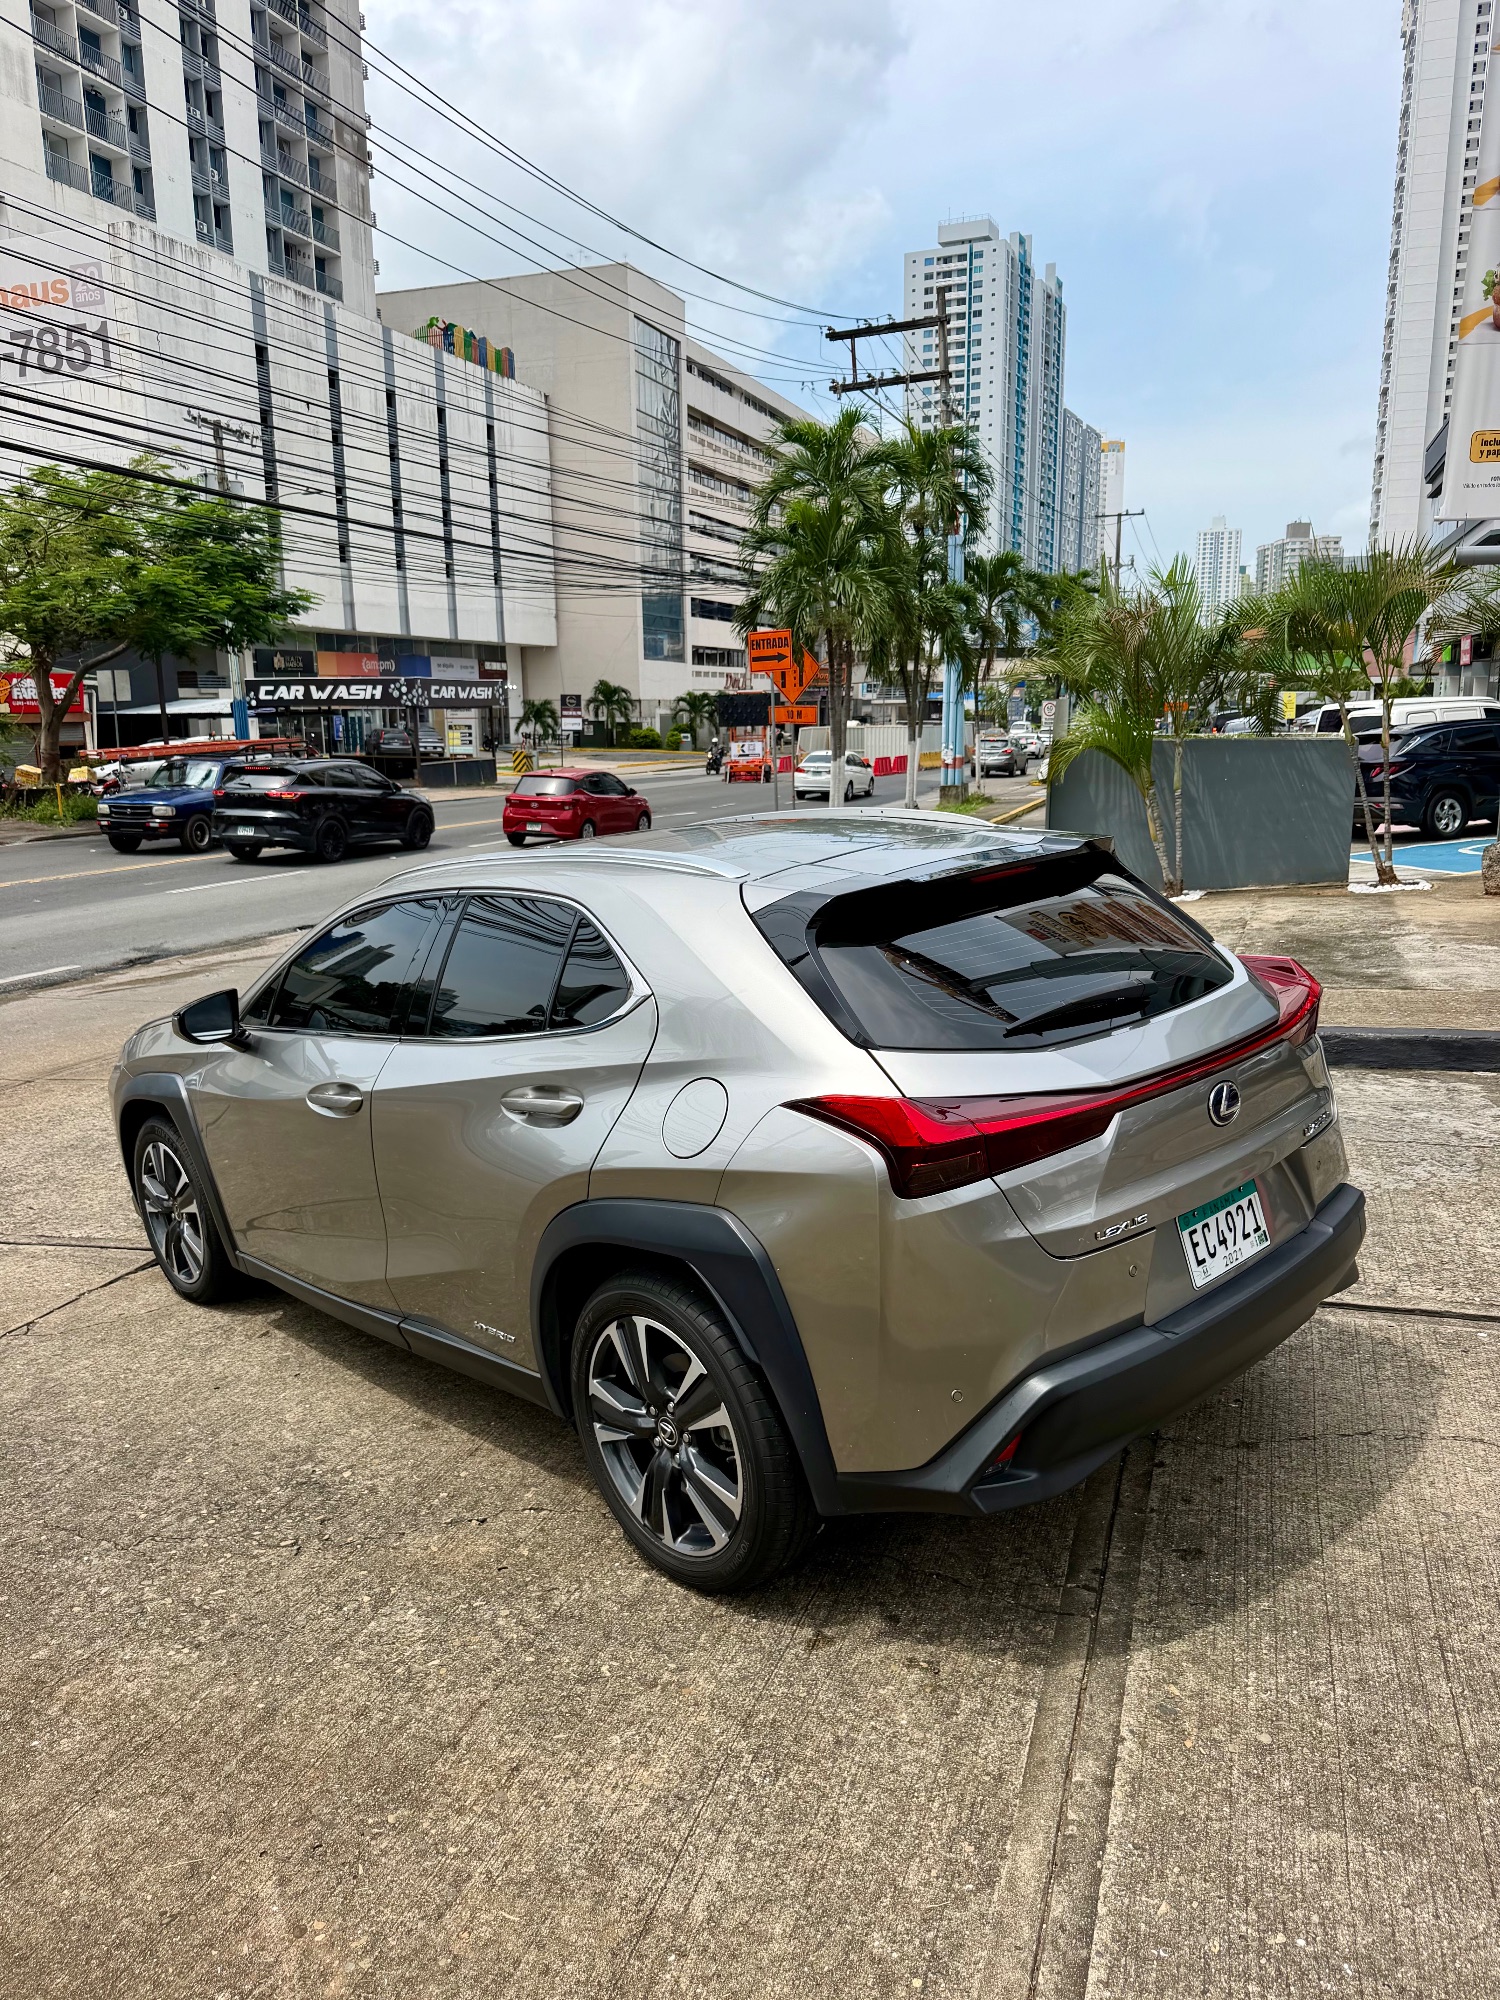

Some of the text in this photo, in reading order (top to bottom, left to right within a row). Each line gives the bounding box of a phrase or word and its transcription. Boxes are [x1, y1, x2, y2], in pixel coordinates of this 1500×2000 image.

[75, 266, 99, 291] 20
[75, 289, 101, 302] años
[751, 636, 789, 651] ENTRADA
[12, 678, 55, 688] ASAS
[12, 688, 66, 699] FARRS
[258, 685, 383, 700] CAR WASH
[430, 685, 493, 699] CAR WASH
[787, 710, 794, 719] 10
[1095, 1213, 1148, 1242] LEXUS
[1188, 1198, 1261, 1267] EC4921
[1223, 1247, 1244, 1268] 2021
